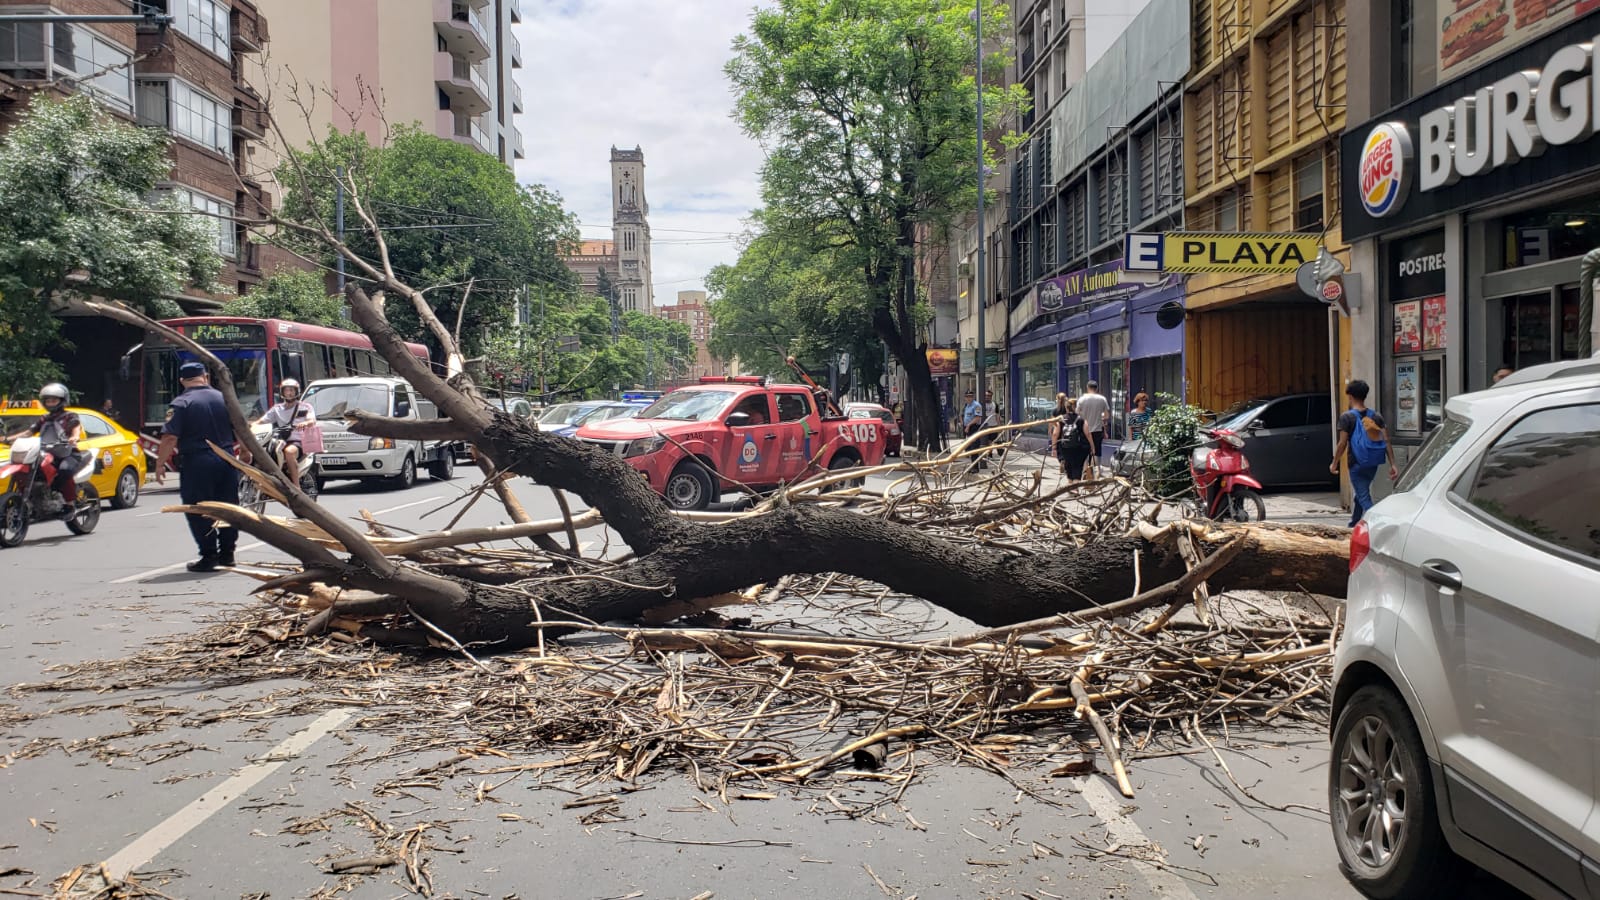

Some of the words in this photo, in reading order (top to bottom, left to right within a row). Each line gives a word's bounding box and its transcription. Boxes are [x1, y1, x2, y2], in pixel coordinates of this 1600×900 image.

[1420, 33, 1600, 193] BURG
[1362, 152, 1393, 202] KING
[1130, 235, 1159, 270] E
[1182, 241, 1305, 265] PLAYA
[1064, 275, 1080, 297] AM
[7, 400, 33, 409] TAXI
[851, 423, 877, 443] 103
[744, 448, 755, 456] DC
